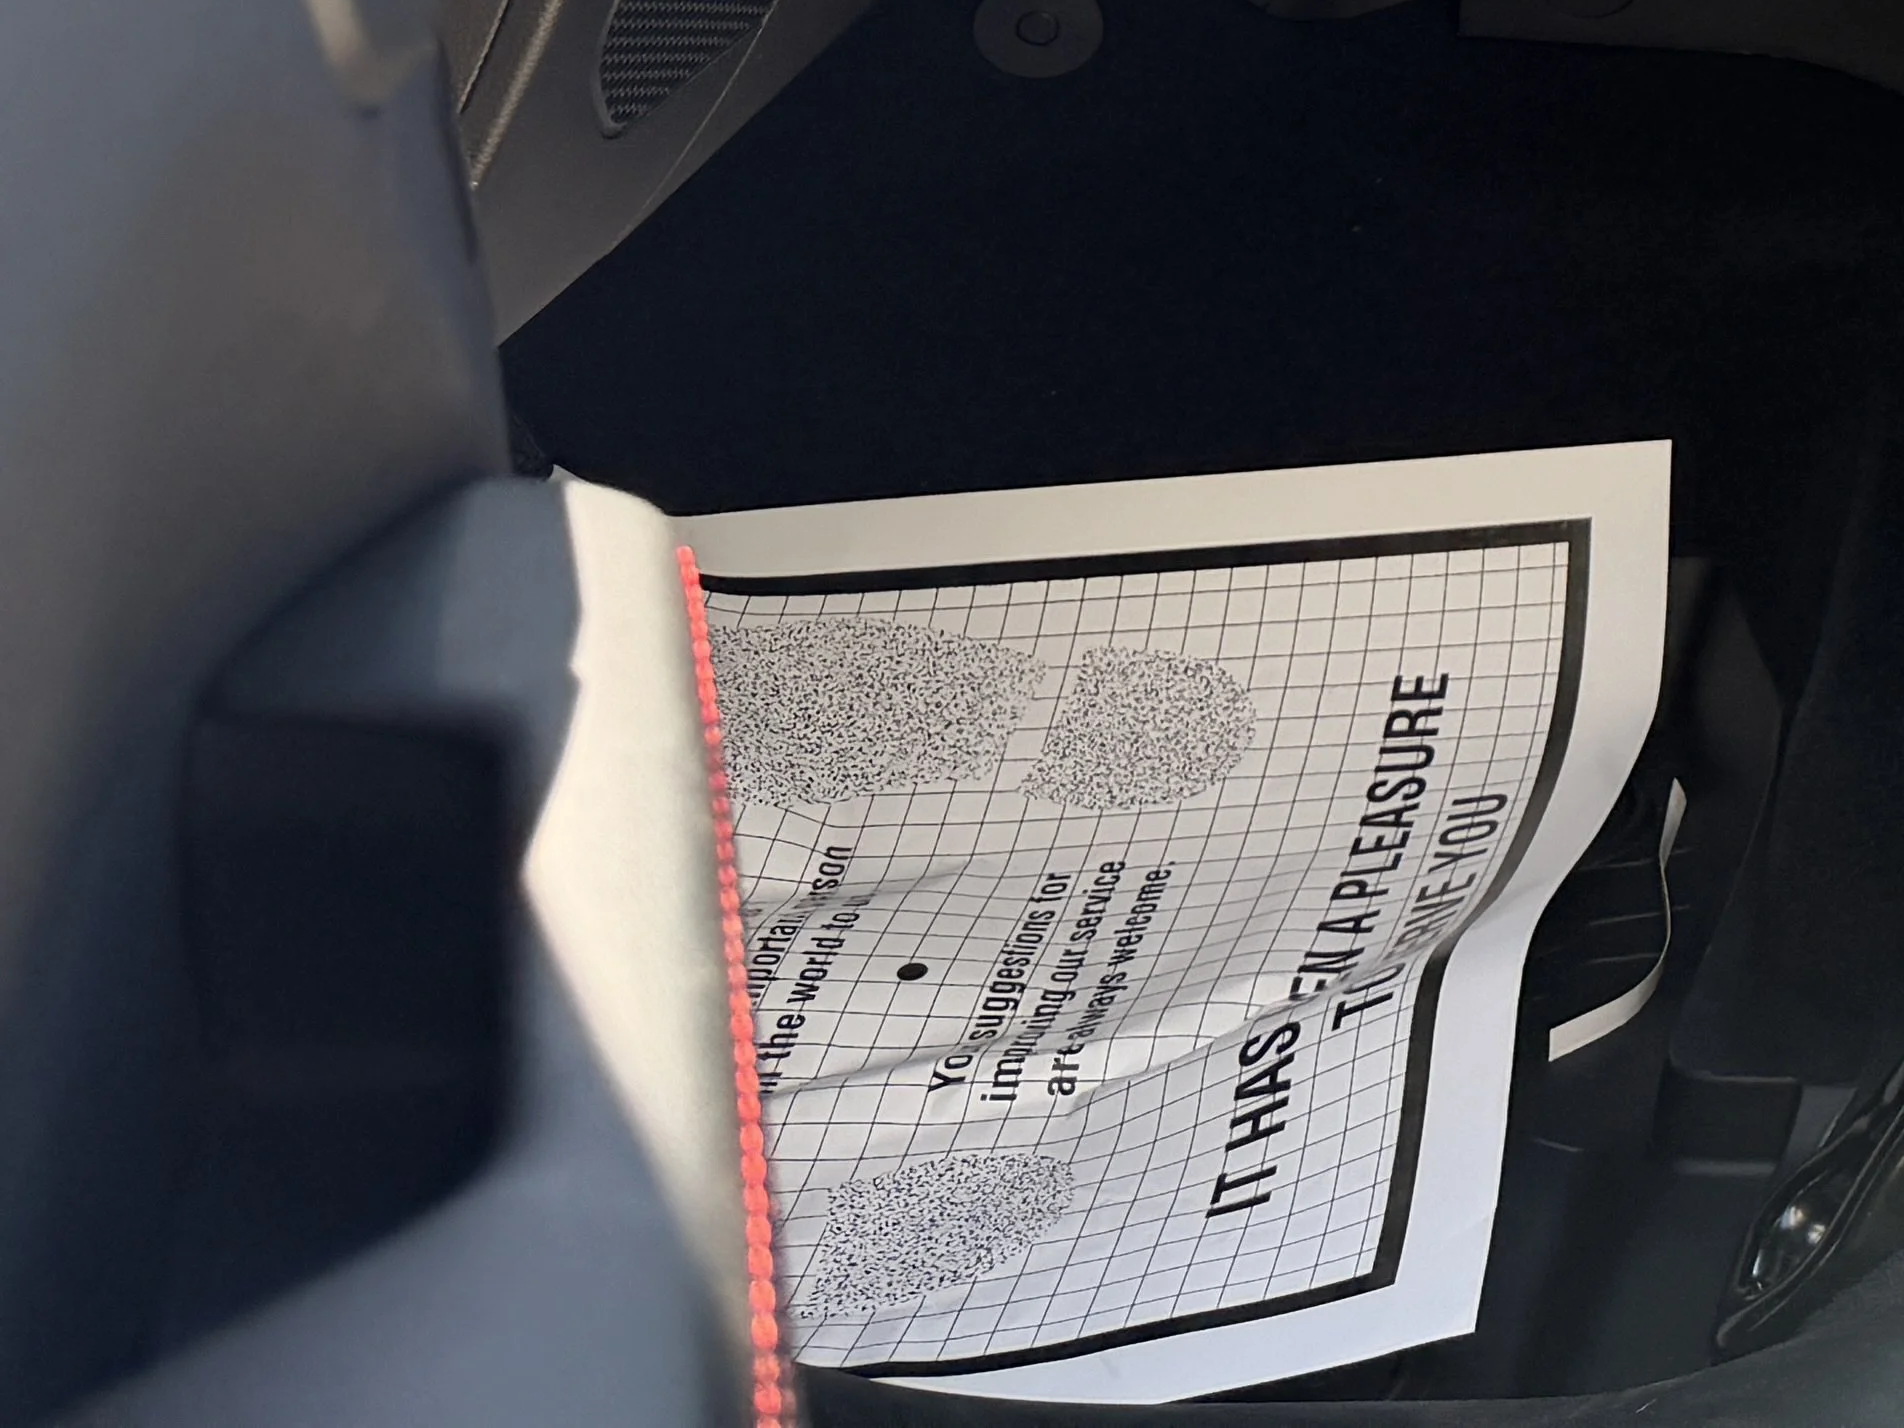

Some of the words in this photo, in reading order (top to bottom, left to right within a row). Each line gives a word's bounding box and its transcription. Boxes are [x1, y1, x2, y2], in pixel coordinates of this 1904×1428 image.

[1329, 672, 1450, 902] PLEASURE
[1427, 793, 1509, 873] YOU
[1069, 860, 1127, 943] service
[1315, 909, 1381, 934] A
[756, 1014, 806, 1061] the
[786, 936, 846, 1004] world
[820, 912, 860, 930] to
[968, 909, 1056, 1041] suggestions
[1028, 872, 1072, 904] for
[1050, 948, 1089, 984] our
[1288, 946, 1366, 1002] EN
[1065, 971, 1129, 1041] always
[1046, 1042, 1086, 1097] are
[1224, 1020, 1301, 1153] HAS
[1204, 1164, 1278, 1219] IT
